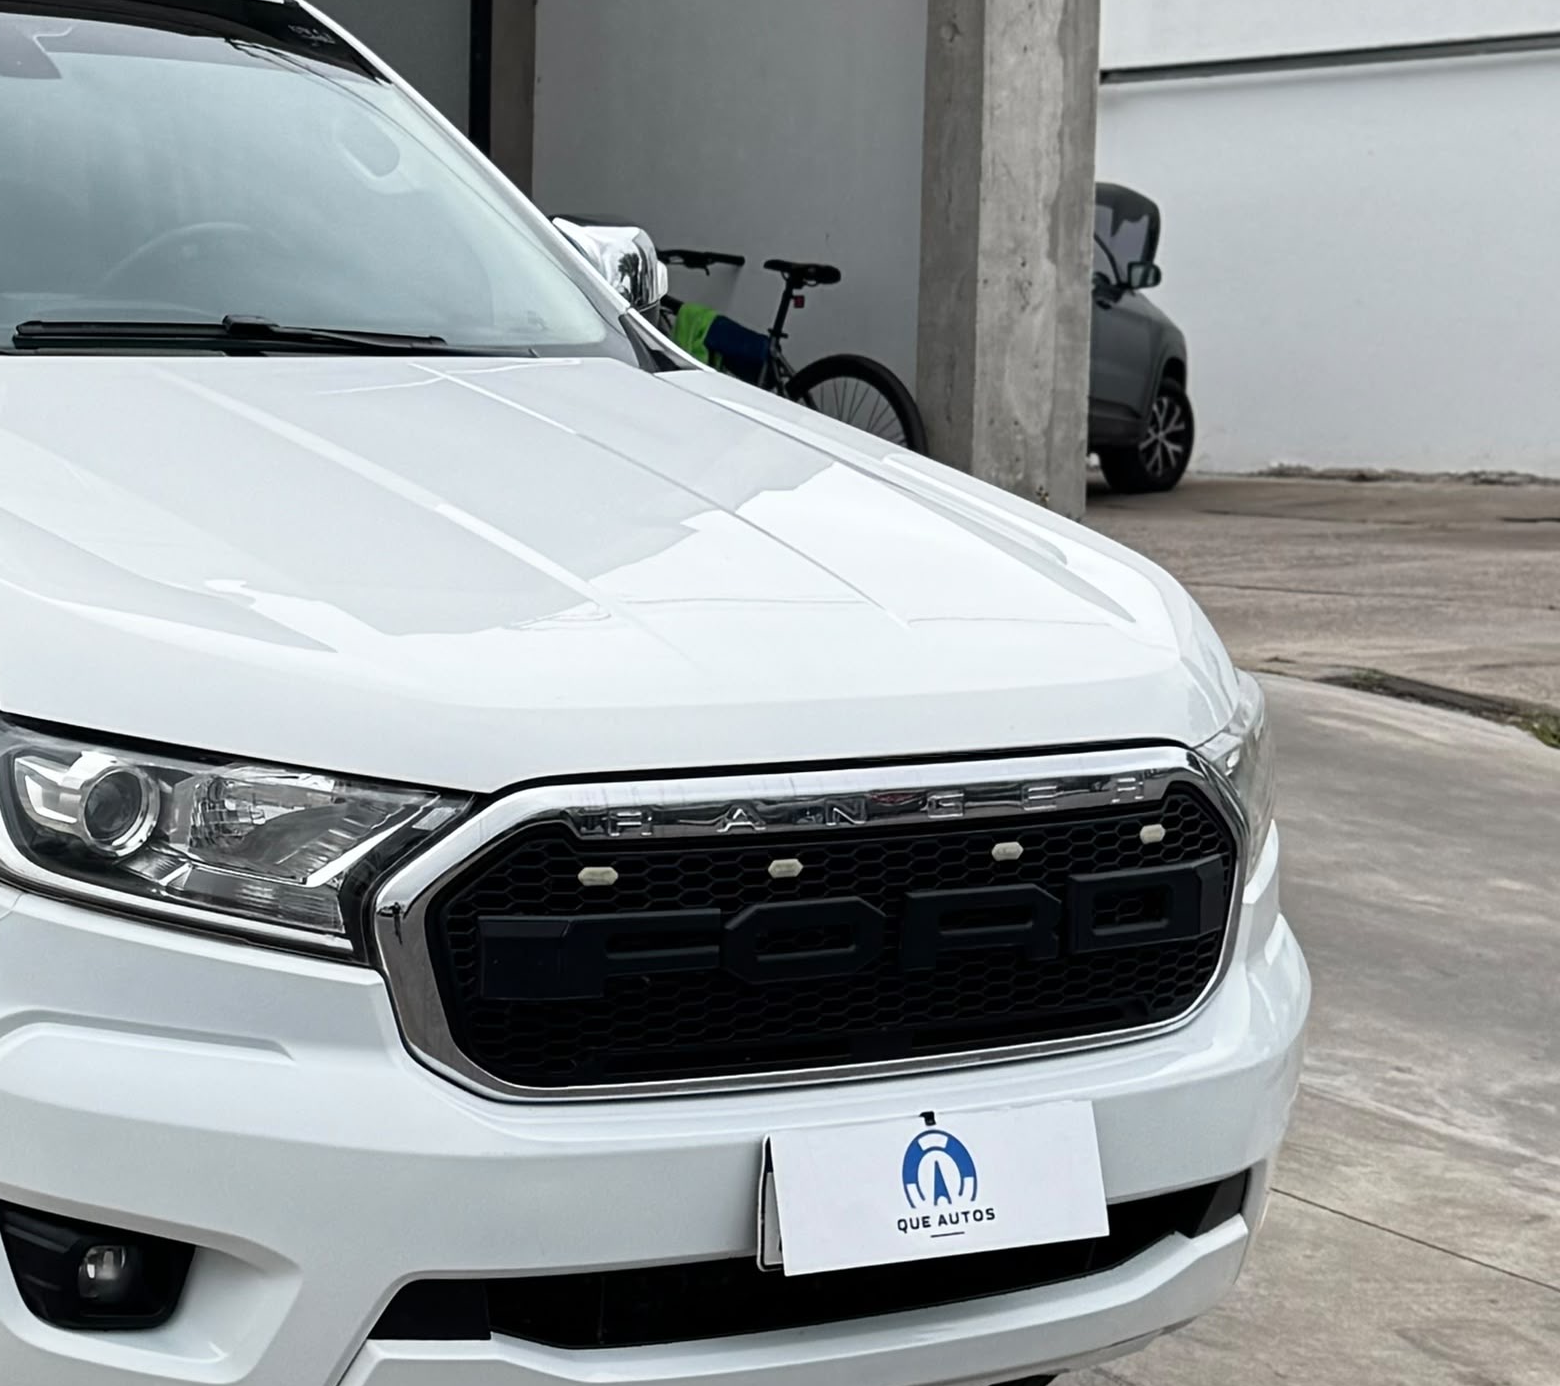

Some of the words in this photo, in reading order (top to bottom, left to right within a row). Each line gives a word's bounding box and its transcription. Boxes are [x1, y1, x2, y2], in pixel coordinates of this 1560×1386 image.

[605, 773, 1144, 836] RANGER
[477, 854, 1223, 1000] FORD
[897, 1215, 931, 1233] QUE
[938, 1208, 996, 1228] AUTOS
